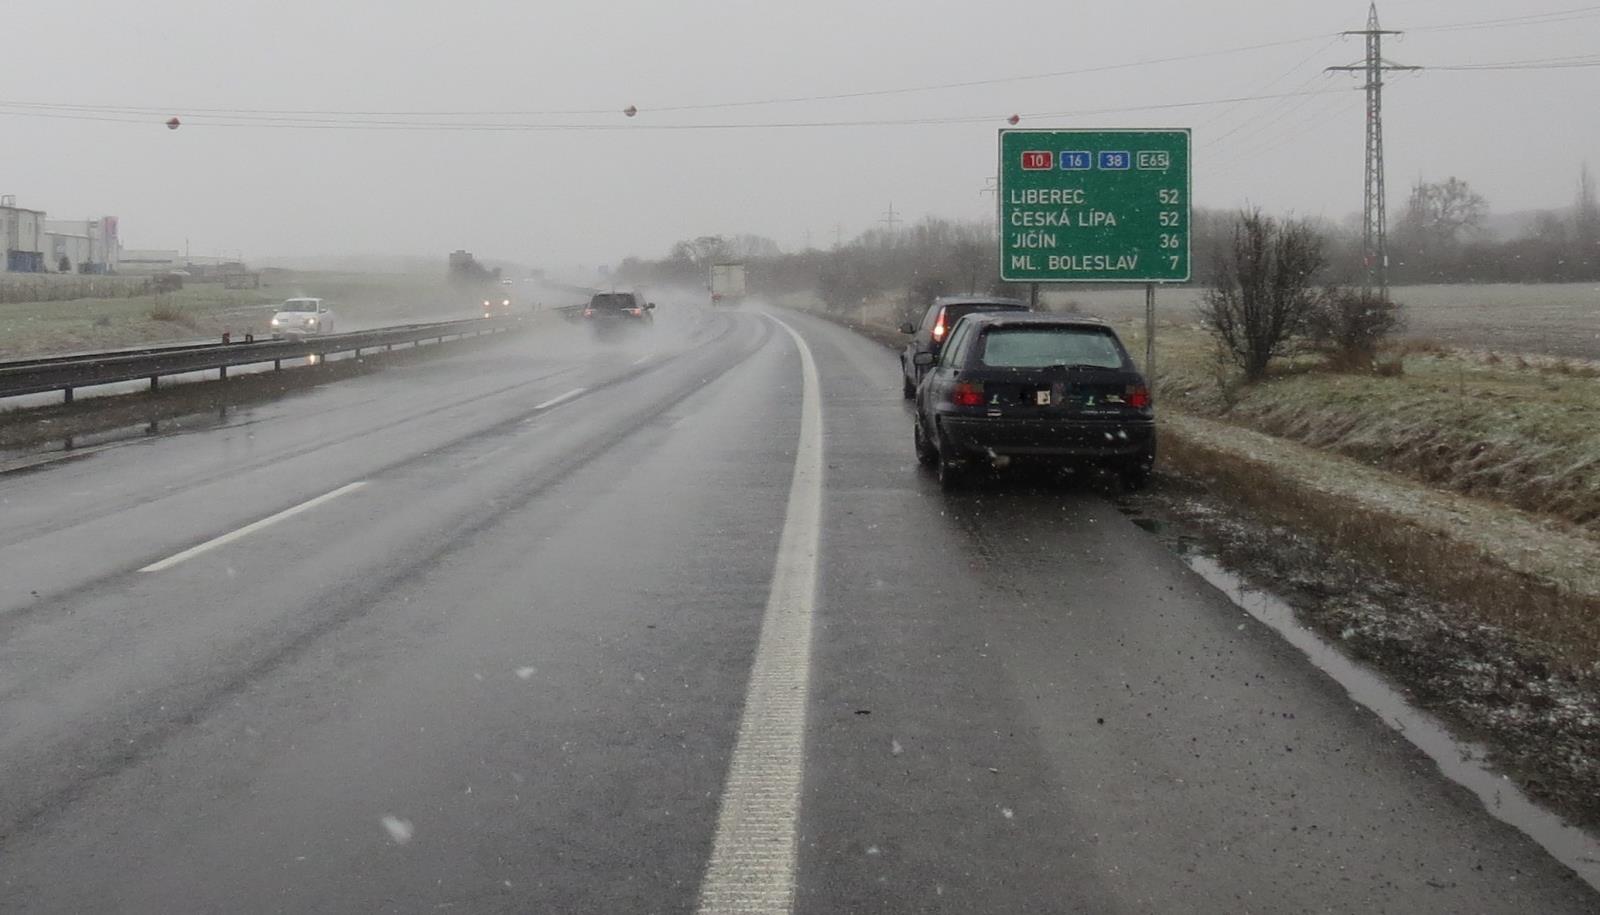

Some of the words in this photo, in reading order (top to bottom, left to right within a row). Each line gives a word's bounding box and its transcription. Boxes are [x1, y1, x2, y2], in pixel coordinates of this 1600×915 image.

[1030, 155, 1044, 167] 10
[1068, 155, 1082, 167] 16
[1105, 155, 1122, 167] 38
[1140, 155, 1165, 167] E65
[1011, 189, 1085, 204] LIBEREC
[1159, 189, 1179, 204] 52
[1011, 208, 1071, 226] ČESKÁ
[1078, 208, 1117, 226] LÍPA
[1159, 211, 1179, 226] 52
[1011, 230, 1056, 248] JIČÍN
[1159, 234, 1179, 248] 36
[1011, 255, 1041, 270] ML.
[1048, 255, 1138, 270] BOLESLAV
[1170, 255, 1179, 270] 7
